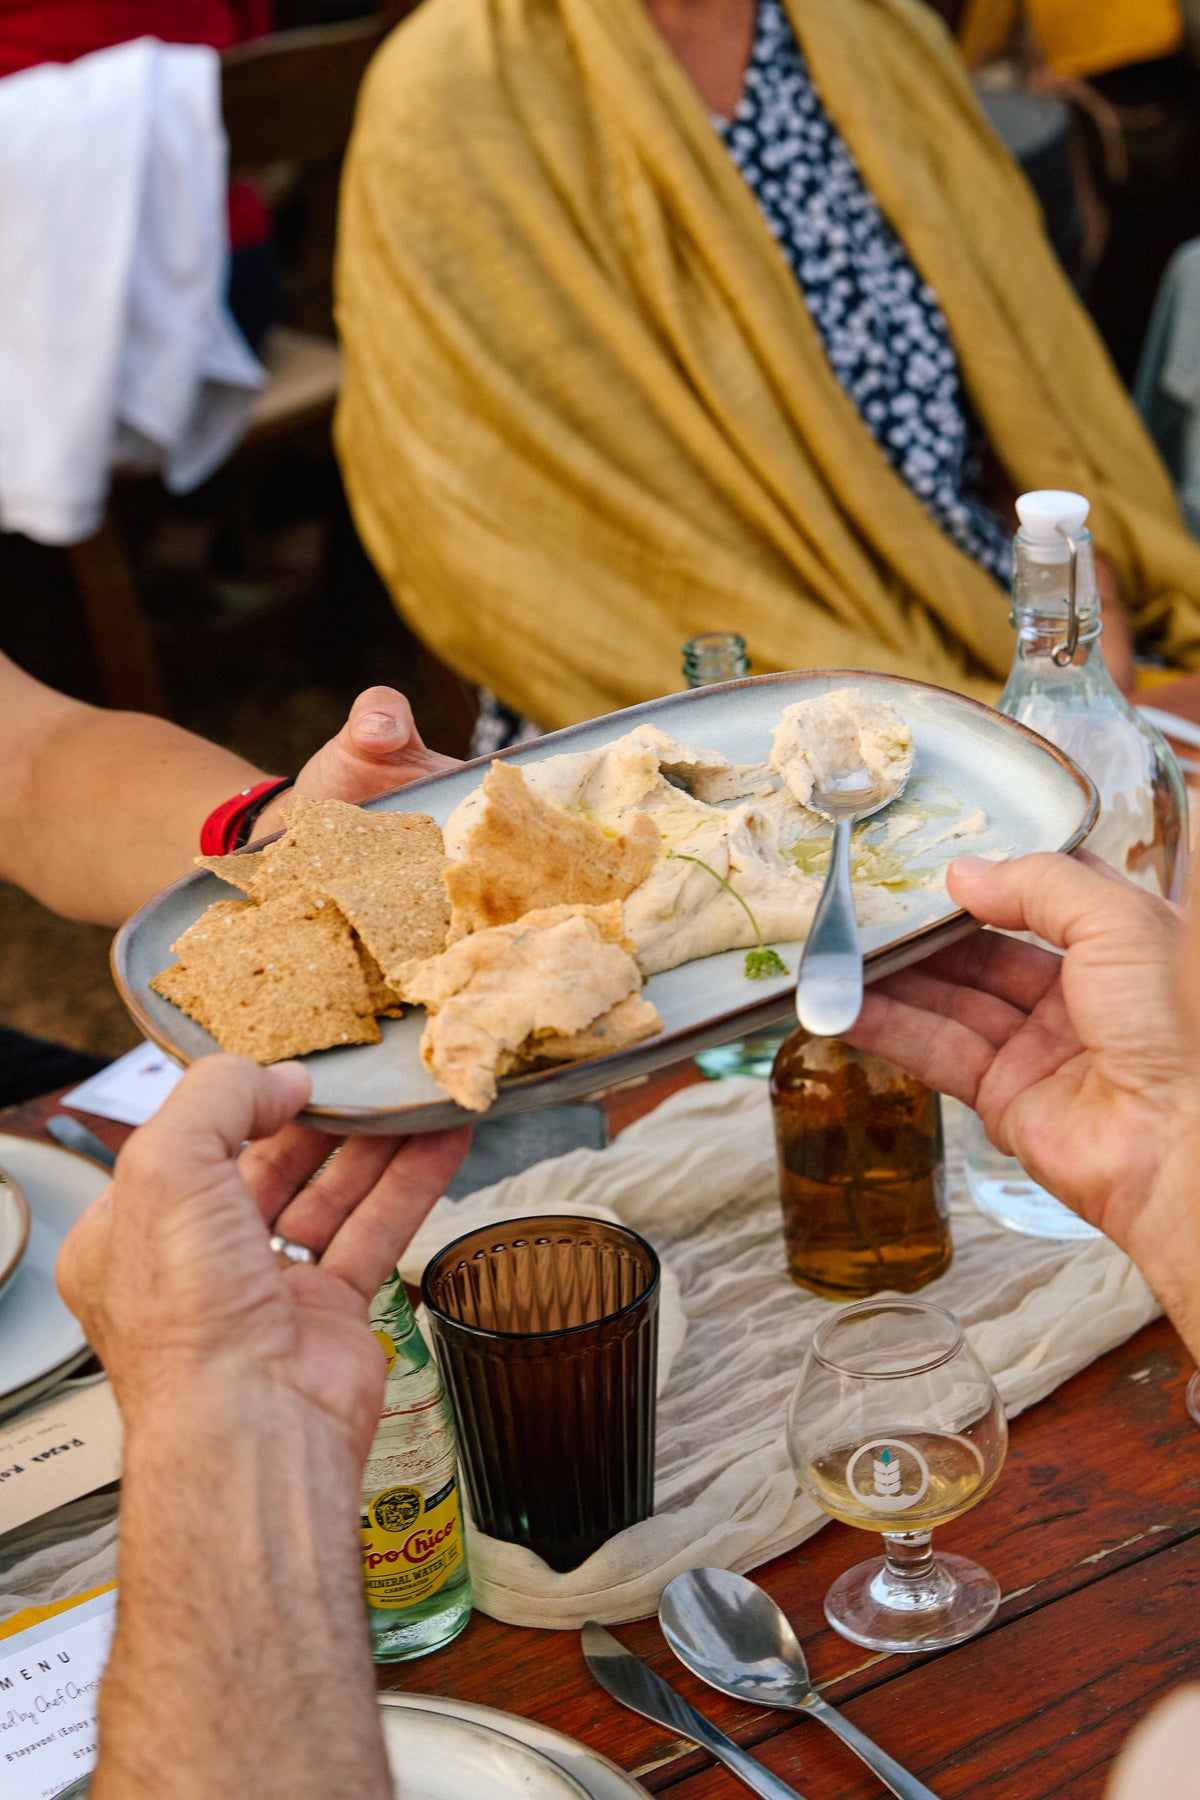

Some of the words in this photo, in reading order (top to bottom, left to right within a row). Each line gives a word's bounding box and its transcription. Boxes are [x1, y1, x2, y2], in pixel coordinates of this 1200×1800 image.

[361, 1542, 403, 1569] po
[403, 1516, 457, 1564] Chico
[412, 1559, 445, 1581] WATER
[0, 1651, 71, 1691] MENU
[34, 1688, 69, 1713] Chef
